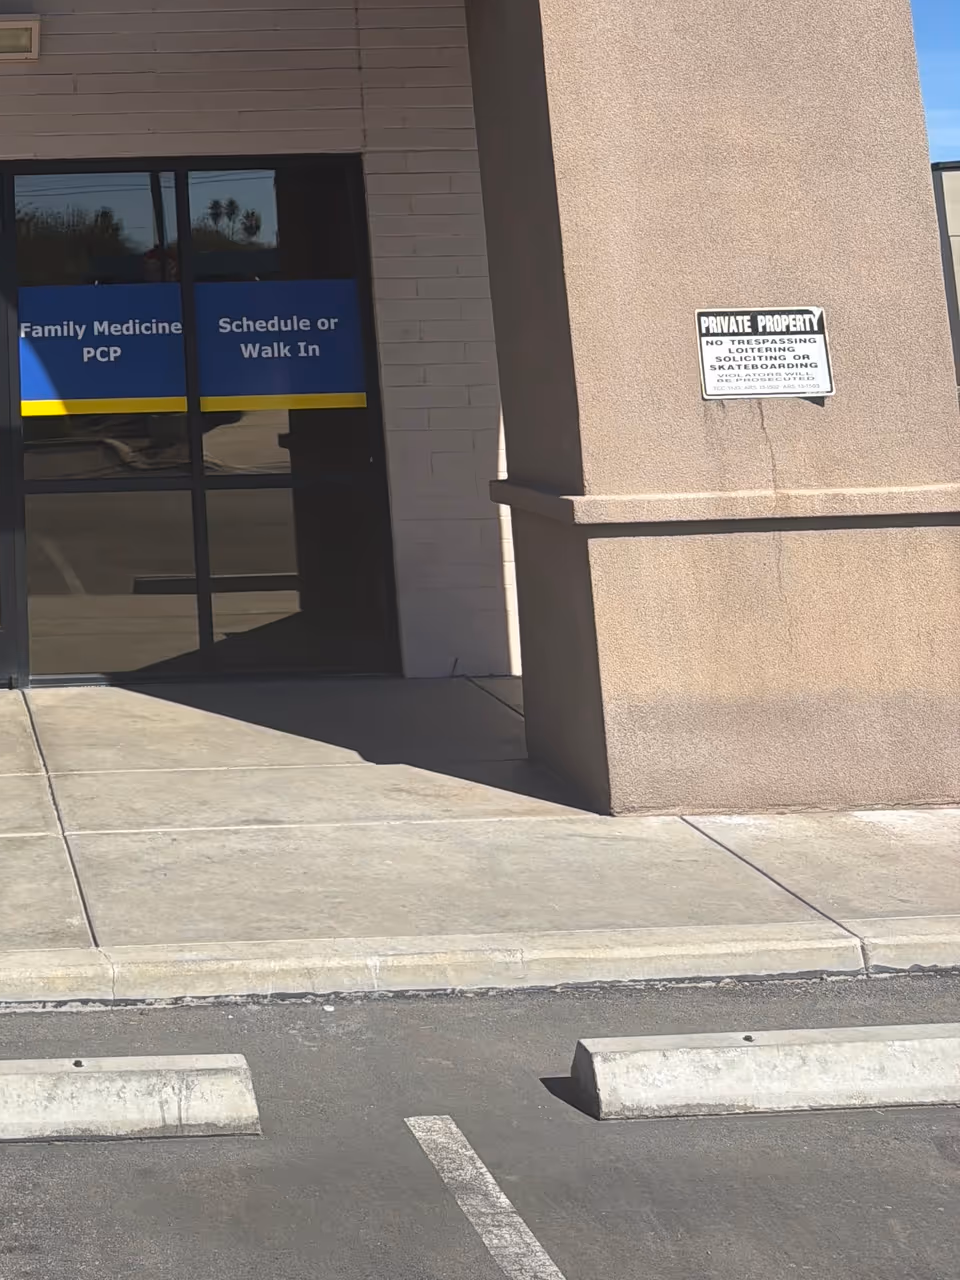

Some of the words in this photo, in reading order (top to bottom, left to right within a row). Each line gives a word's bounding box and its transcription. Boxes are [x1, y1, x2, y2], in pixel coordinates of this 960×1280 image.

[20, 322, 86, 340] Family
[93, 320, 182, 336] Medicine
[218, 316, 310, 333] Schedule
[317, 319, 338, 331] or
[700, 315, 752, 334] PRIVATE
[757, 313, 818, 333] PROPERTY
[240, 341, 291, 358] Walk
[298, 342, 320, 357] In
[729, 338, 817, 346] TRESPASSING
[83, 347, 122, 362] PCP
[728, 346, 796, 354] LOITERING
[709, 362, 819, 371] SKATEBOARDING
[715, 355, 787, 363] SOLICITING
